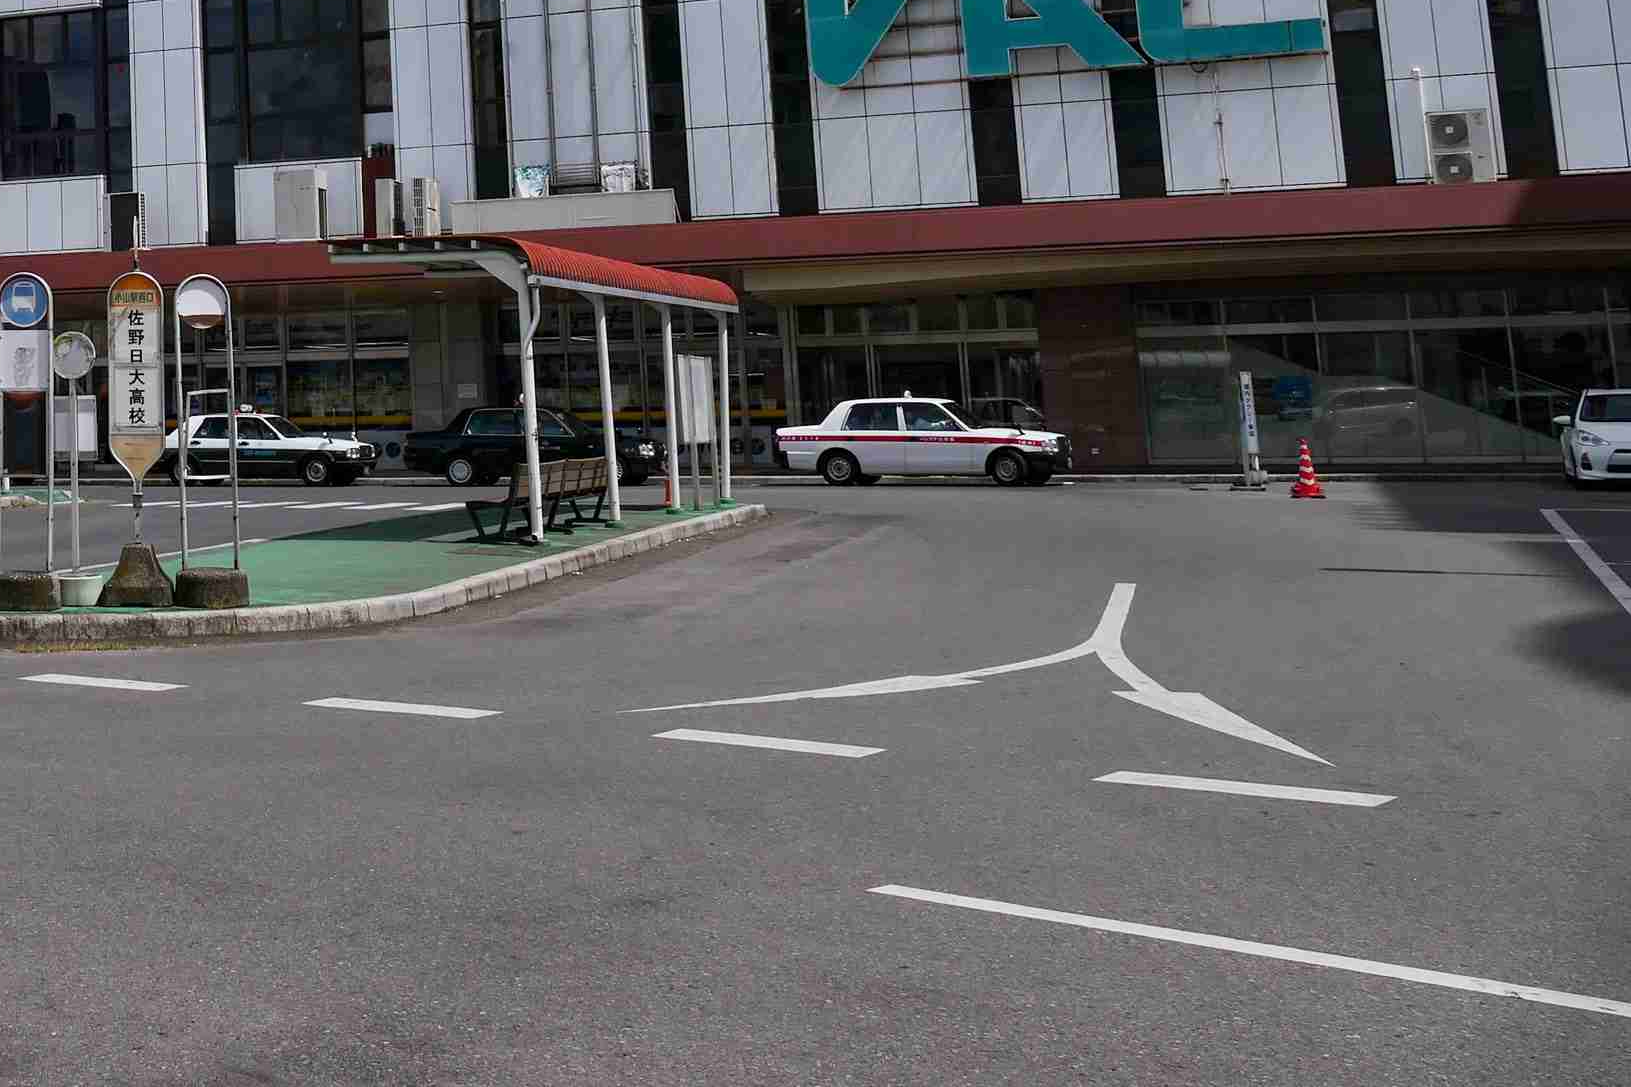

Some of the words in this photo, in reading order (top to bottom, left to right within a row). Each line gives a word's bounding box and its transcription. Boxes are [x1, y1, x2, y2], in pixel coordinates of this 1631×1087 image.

[127, 309, 146, 425] 佐野日大高校
